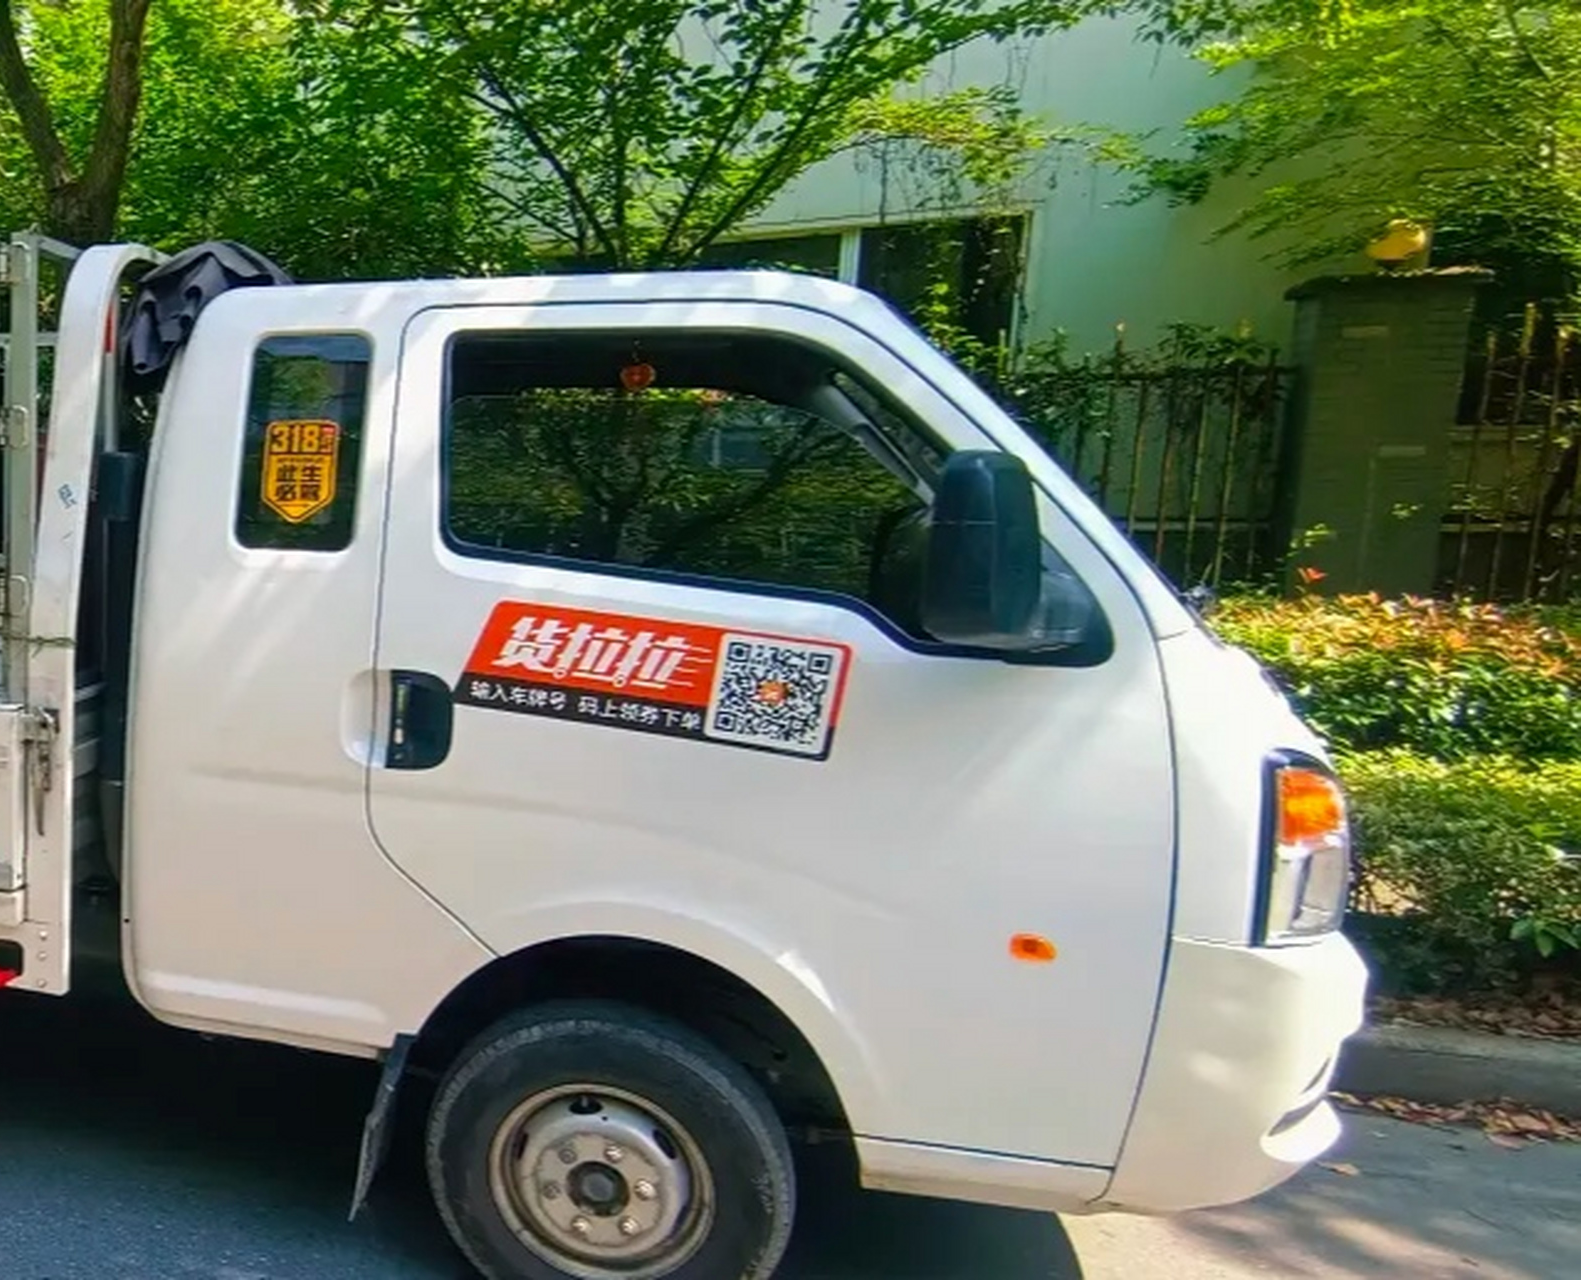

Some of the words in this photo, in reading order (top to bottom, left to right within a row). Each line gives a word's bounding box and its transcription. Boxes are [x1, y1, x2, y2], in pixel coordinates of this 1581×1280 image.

[271, 425, 319, 453] 318
[492, 616, 698, 690] 货拉拉
[471, 680, 567, 711] 输入车牌号
[577, 695, 703, 730] 码上领券下单
